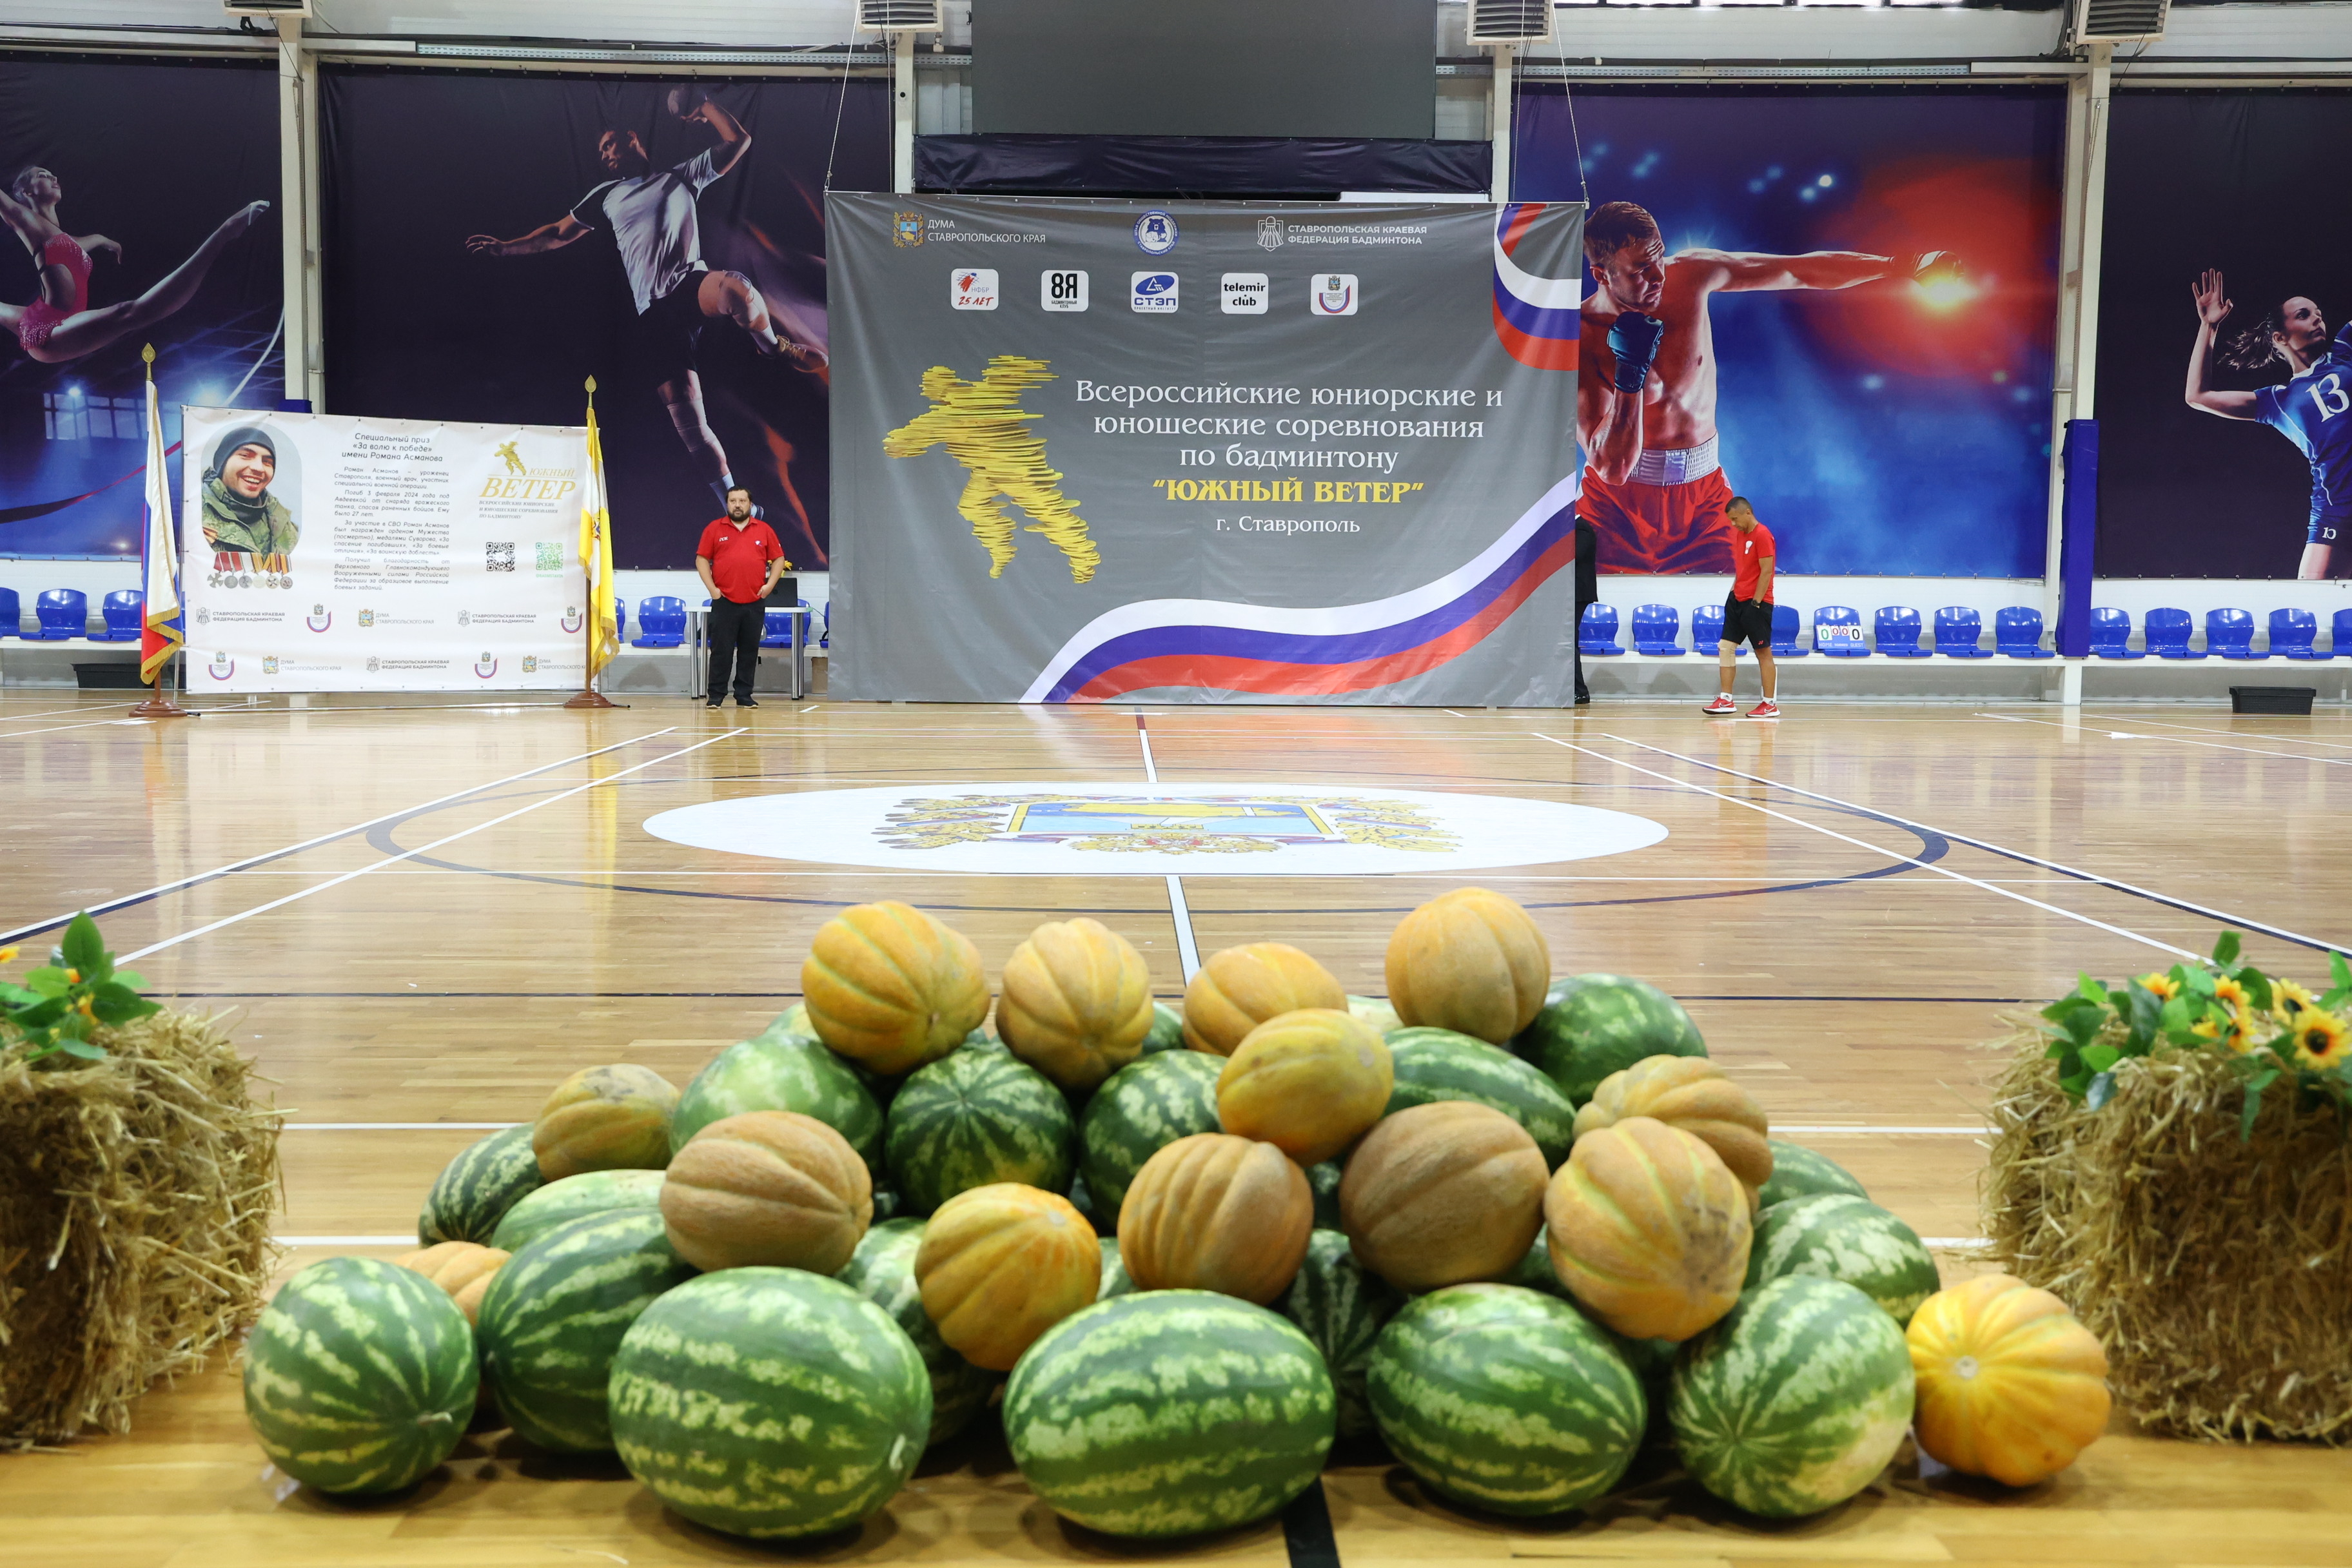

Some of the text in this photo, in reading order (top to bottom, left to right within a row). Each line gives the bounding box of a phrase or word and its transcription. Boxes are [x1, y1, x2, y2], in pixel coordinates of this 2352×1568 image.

[928, 220, 955, 229] ДУМА
[928, 233, 1045, 242] СТАВРОПОЛЬСКОГО КРАЯ
[1052, 273, 1077, 299] 8Я
[1224, 282, 1266, 291] telemir
[959, 296, 994, 306] 25 ЛЕТ
[1233, 297, 1257, 306] club
[1075, 380, 1503, 411] Всероссийские юниорские и
[2306, 373, 2349, 422] 13
[1094, 416, 1483, 442] юношеские соревнования
[355, 433, 409, 442] Специальный
[1180, 442, 1399, 473] по бадминтону
[529, 467, 574, 477] ЮЖНЫЙ
[479, 478, 576, 500] ВЕТЕР
[1216, 517, 1360, 535] г. Ставрополь
[1821, 629, 1828, 640] 0
[1852, 629, 1859, 640] 0
